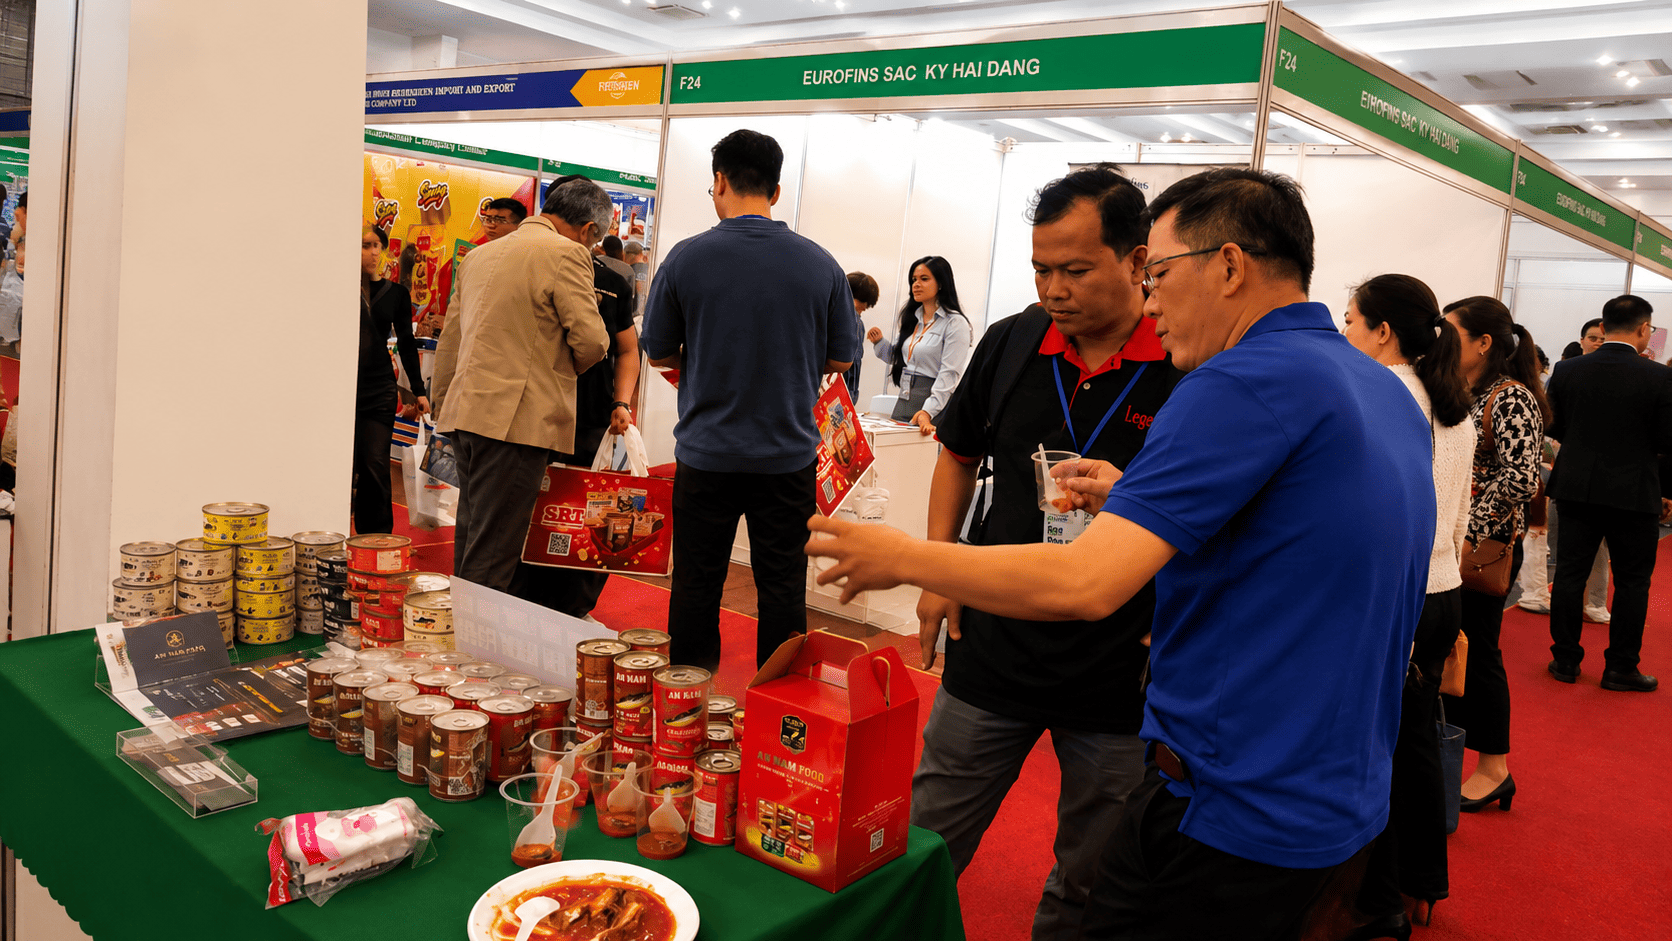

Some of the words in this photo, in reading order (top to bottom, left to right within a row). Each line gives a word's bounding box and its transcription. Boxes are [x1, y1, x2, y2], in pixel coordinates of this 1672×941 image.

[1279, 48, 1297, 73] F24
[803, 67, 879, 86] EUROFINS
[883, 65, 917, 82] SAC
[925, 63, 949, 80] KY
[952, 61, 982, 79] HAI
[986, 58, 1040, 77] DANG
[465, 84, 482, 94] AND
[483, 83, 516, 94] EXPORT
[680, 76, 701, 90] F24
[1401, 110, 1417, 133] SAC
[799, 765, 825, 784] FOOD
